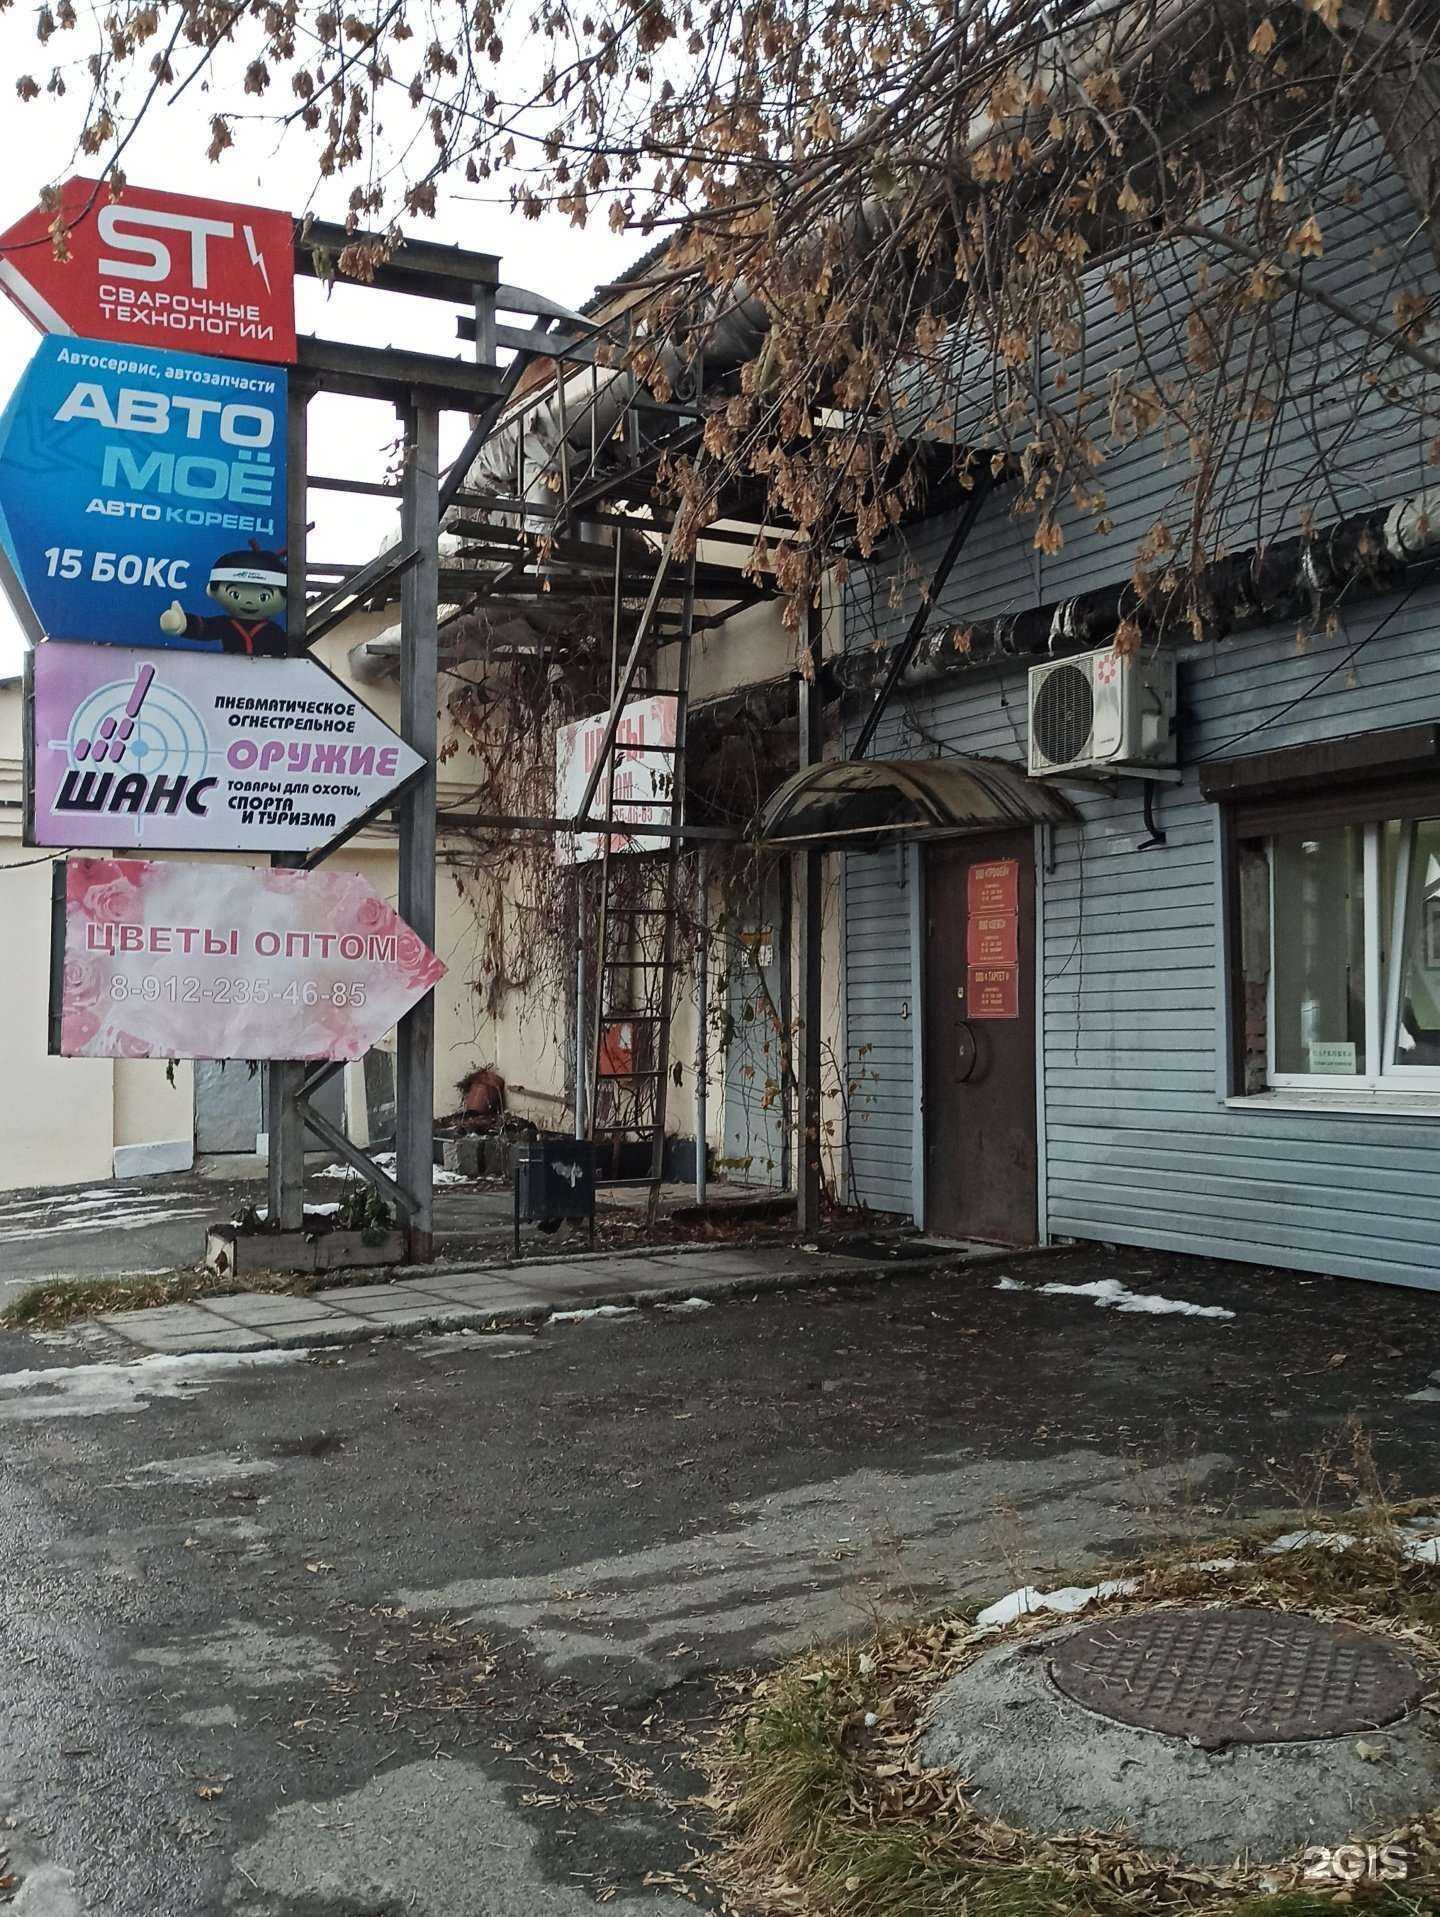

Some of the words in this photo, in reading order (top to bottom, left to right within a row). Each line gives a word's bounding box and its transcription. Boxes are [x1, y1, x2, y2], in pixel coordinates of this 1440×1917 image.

[98, 204, 234, 289] ST
[99, 285, 260, 320] СВАРОЧНЫЕ
[99, 304, 274, 341] ТЕХНОЛОГИИ
[57, 348, 161, 379] Автосервис,
[164, 366, 275, 394] автозапчасти
[54, 382, 275, 448] АВТО
[102, 445, 275, 506] МОЁ
[85, 498, 161, 521] АВТО
[165, 507, 274, 535] КОРЕЕЦ
[45, 547, 83, 580] 15
[91, 551, 191, 590] БОКС
[214, 695, 356, 716] ПНЕВМАТИЧЕСКОЕ
[228, 714, 356, 733] ОГНЕСТРЕЛЬНОЕ
[227, 739, 399, 777] ОРУЖИЕ
[55, 770, 219, 817] ШАНС
[228, 780, 281, 793] ТОВАРЫ
[283, 782, 309, 796] ДЛЯ
[312, 784, 361, 797] ОХОТЫ,
[228, 796, 293, 812] СПОРТА
[241, 811, 254, 824] И
[258, 811, 336, 827] ТУРИЗМА
[86, 923, 238, 957] ЦВЕТЫ
[253, 931, 398, 963] ОПТОМ
[109, 975, 367, 1008] 8-912-235-46-85
